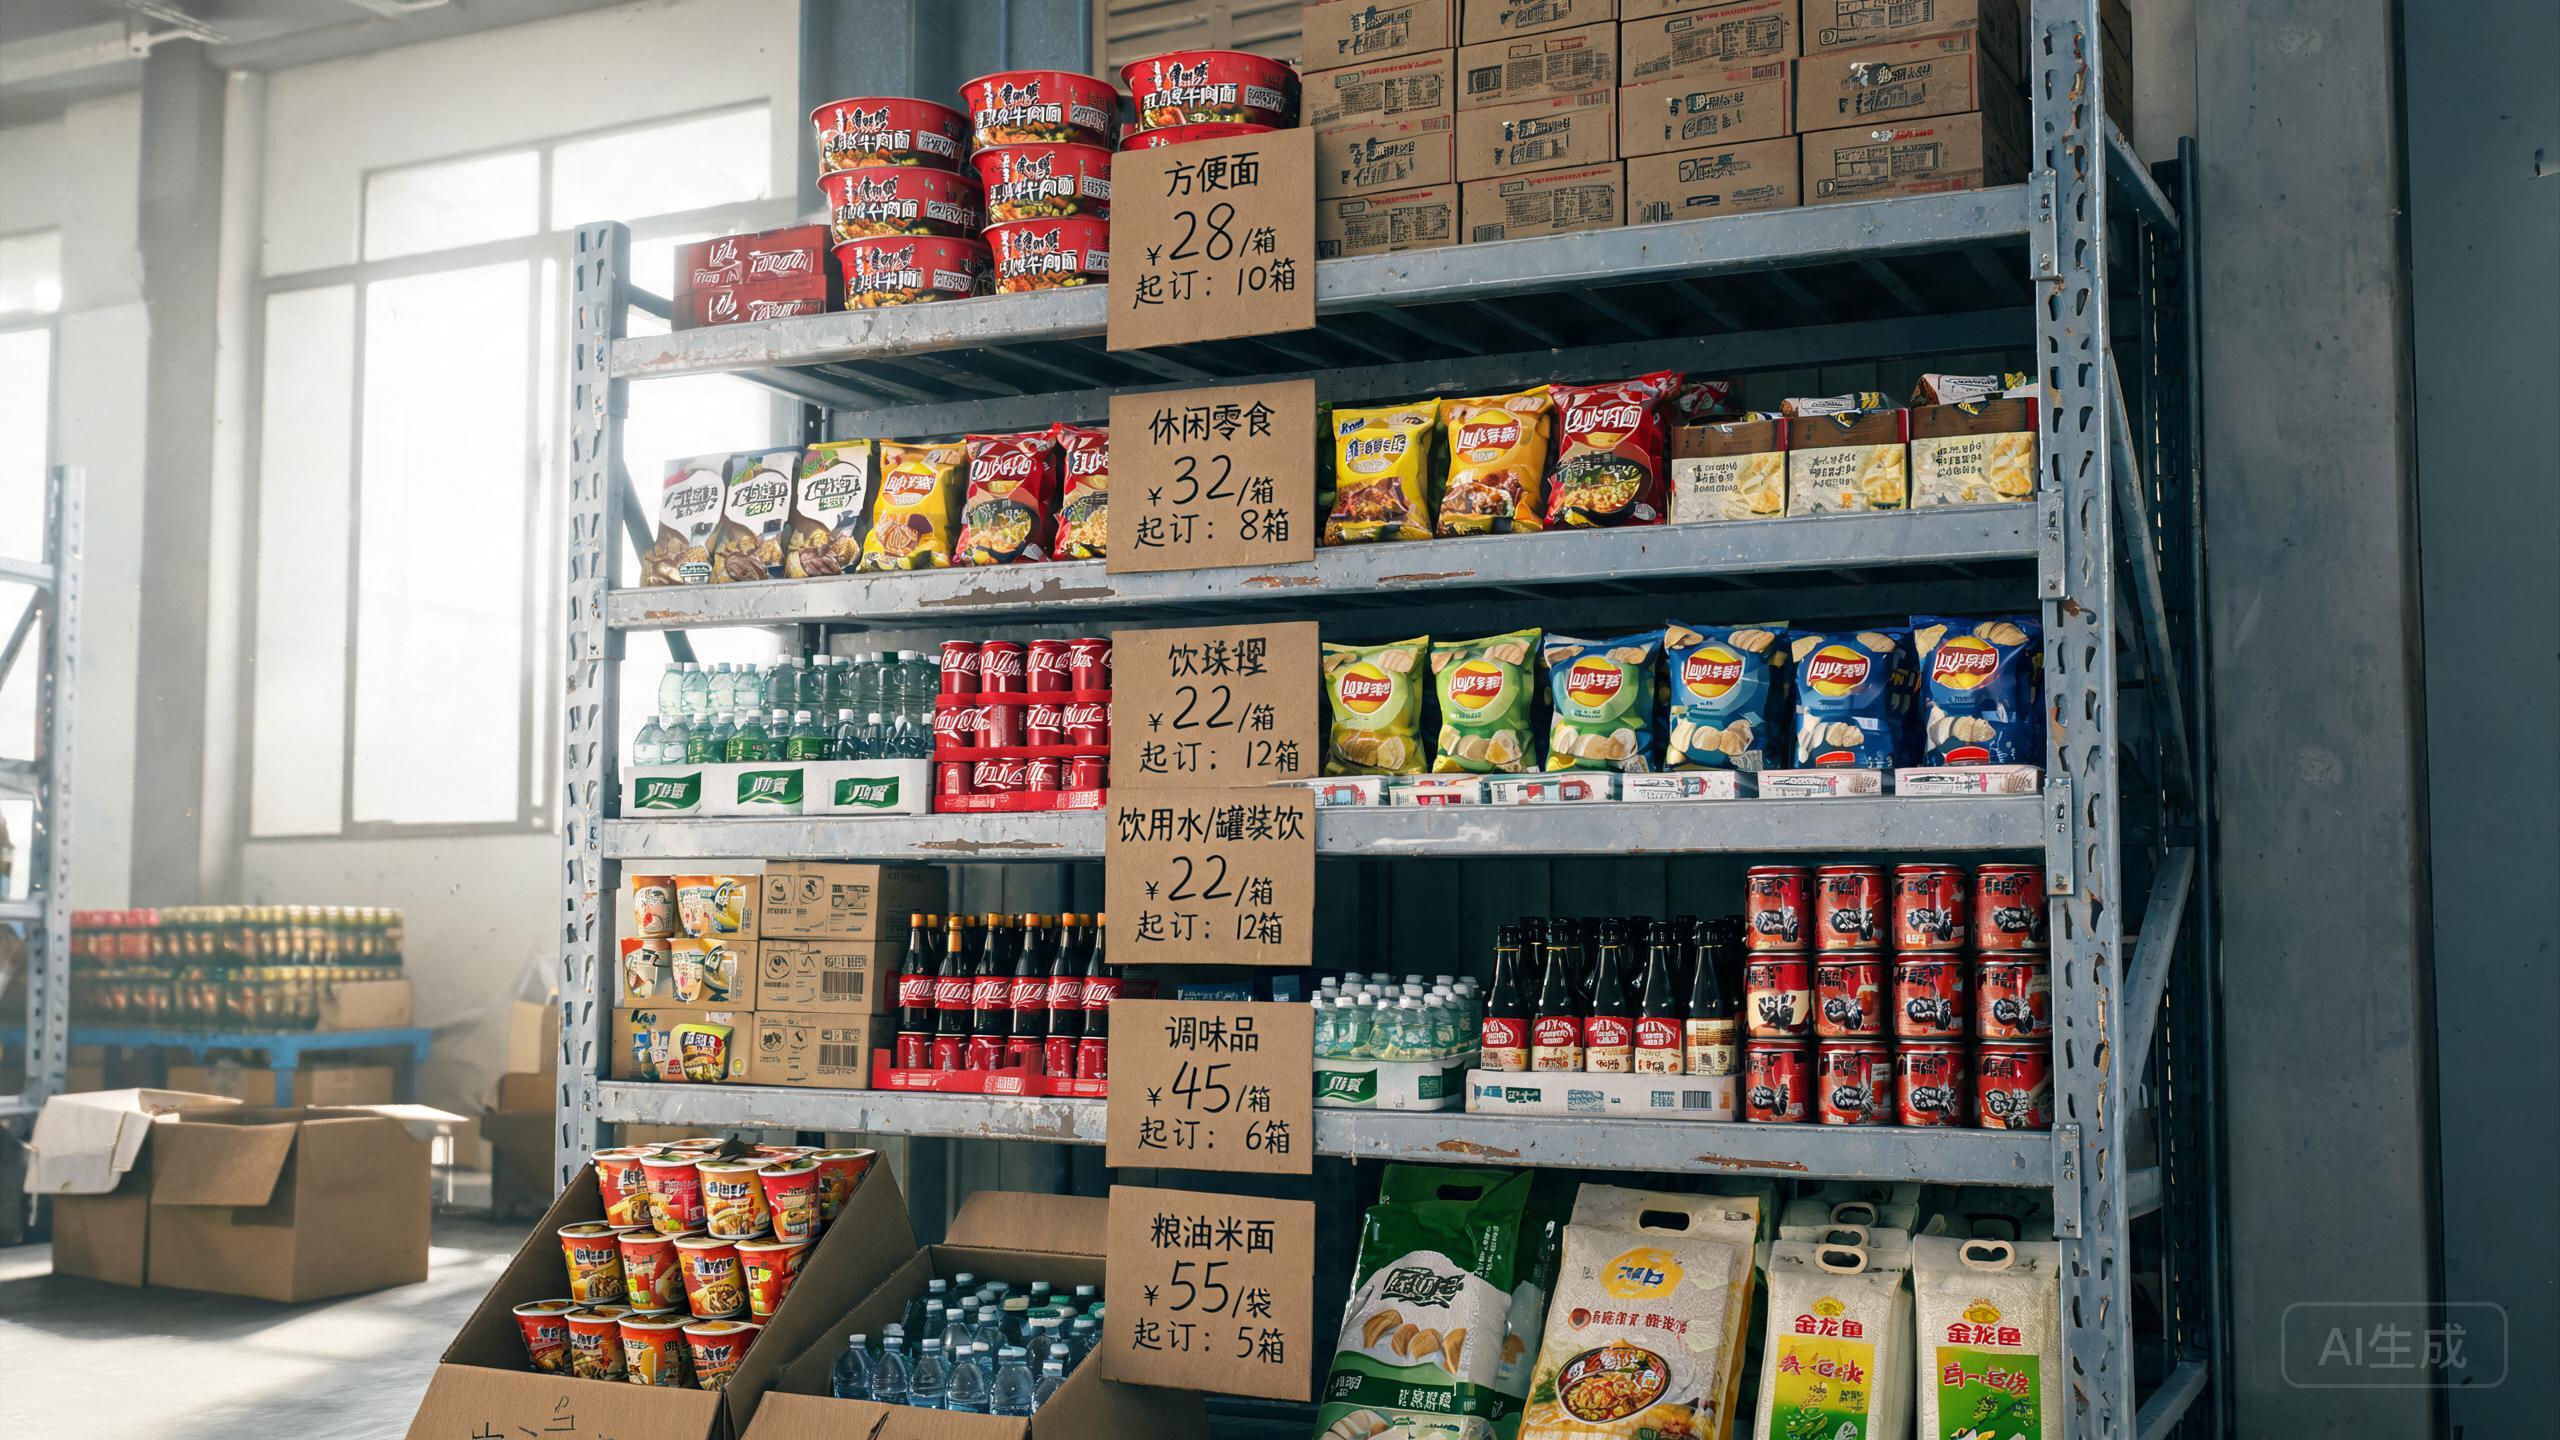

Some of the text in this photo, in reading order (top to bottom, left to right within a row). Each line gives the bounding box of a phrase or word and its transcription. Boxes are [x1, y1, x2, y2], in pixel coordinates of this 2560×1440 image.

[1165, 152, 1259, 197] 方便面
[1146, 203, 1276, 268] ¥28/箱
[1149, 401, 1276, 446] 休闲零食
[1148, 455, 1274, 507] ¥32/箱
[1148, 685, 1274, 734] ¥22/箱
[1119, 804, 1305, 843] 饮用水/罐装饮
[1145, 855, 1273, 907] ¥22/箱
[1165, 1016, 1258, 1053] 调味品
[1147, 1061, 1270, 1114] ¥45/箱
[1151, 1213, 1275, 1255] 粮油米面
[1144, 1260, 1272, 1319] ¥55/袋
[1794, 1314, 1863, 1339] 金龙鱼
